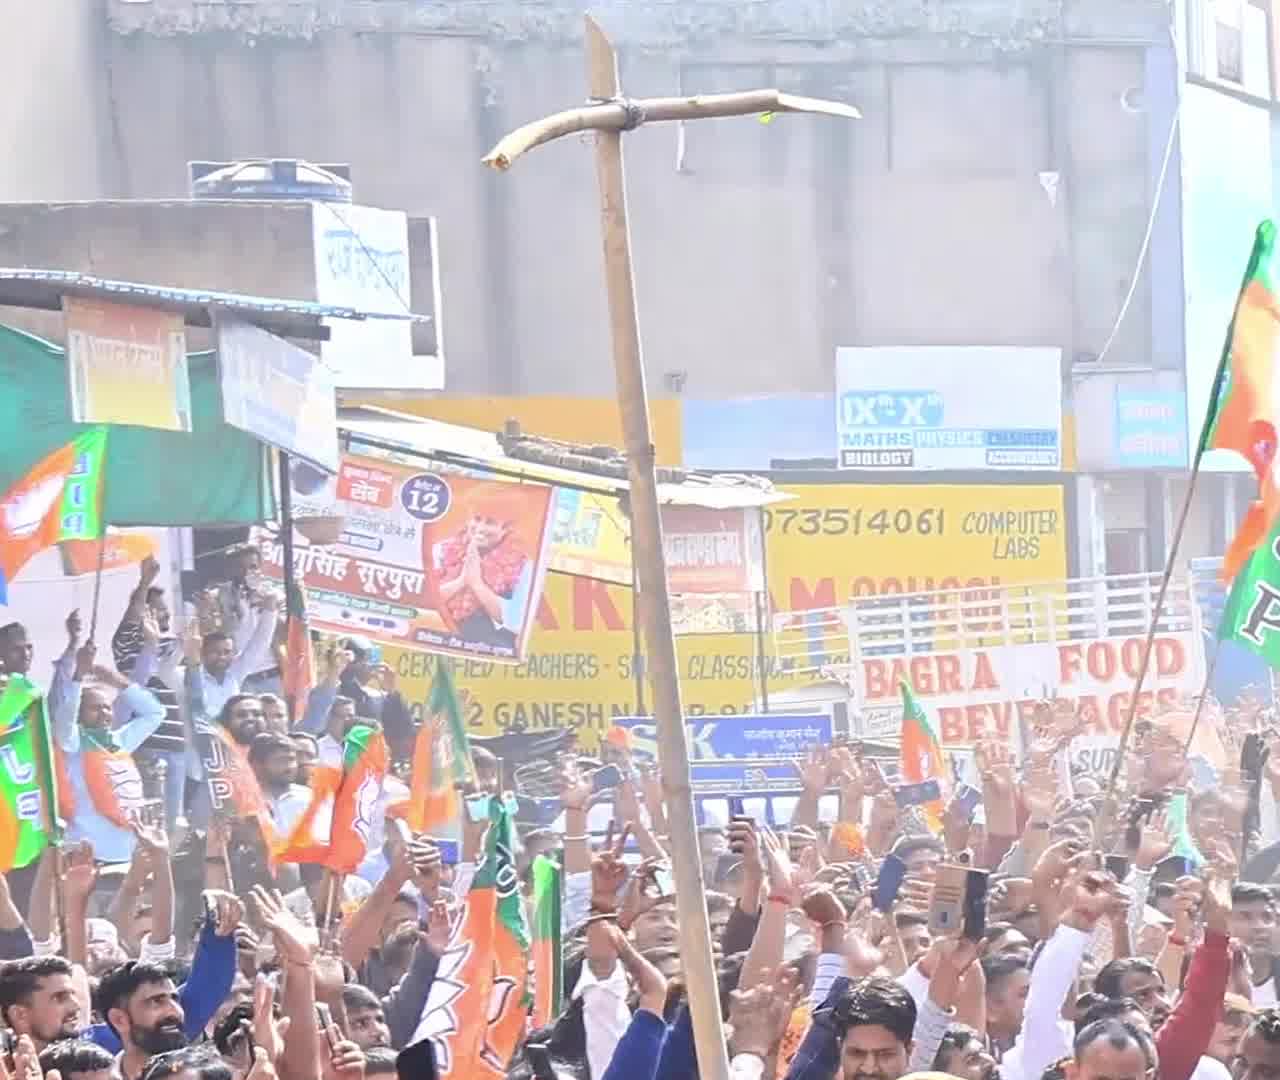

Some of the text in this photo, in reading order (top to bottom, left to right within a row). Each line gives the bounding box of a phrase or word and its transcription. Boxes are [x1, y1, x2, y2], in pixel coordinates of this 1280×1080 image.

[841, 431, 912, 447] MATHS
[843, 450, 912, 465] BIOLOGY
[408, 489, 440, 513] 12
[961, 510, 1057, 534] COMPUTER
[992, 536, 1041, 560] LABS
[1055, 637, 1187, 685] FOOD
[493, 702, 601, 728] GANESH
